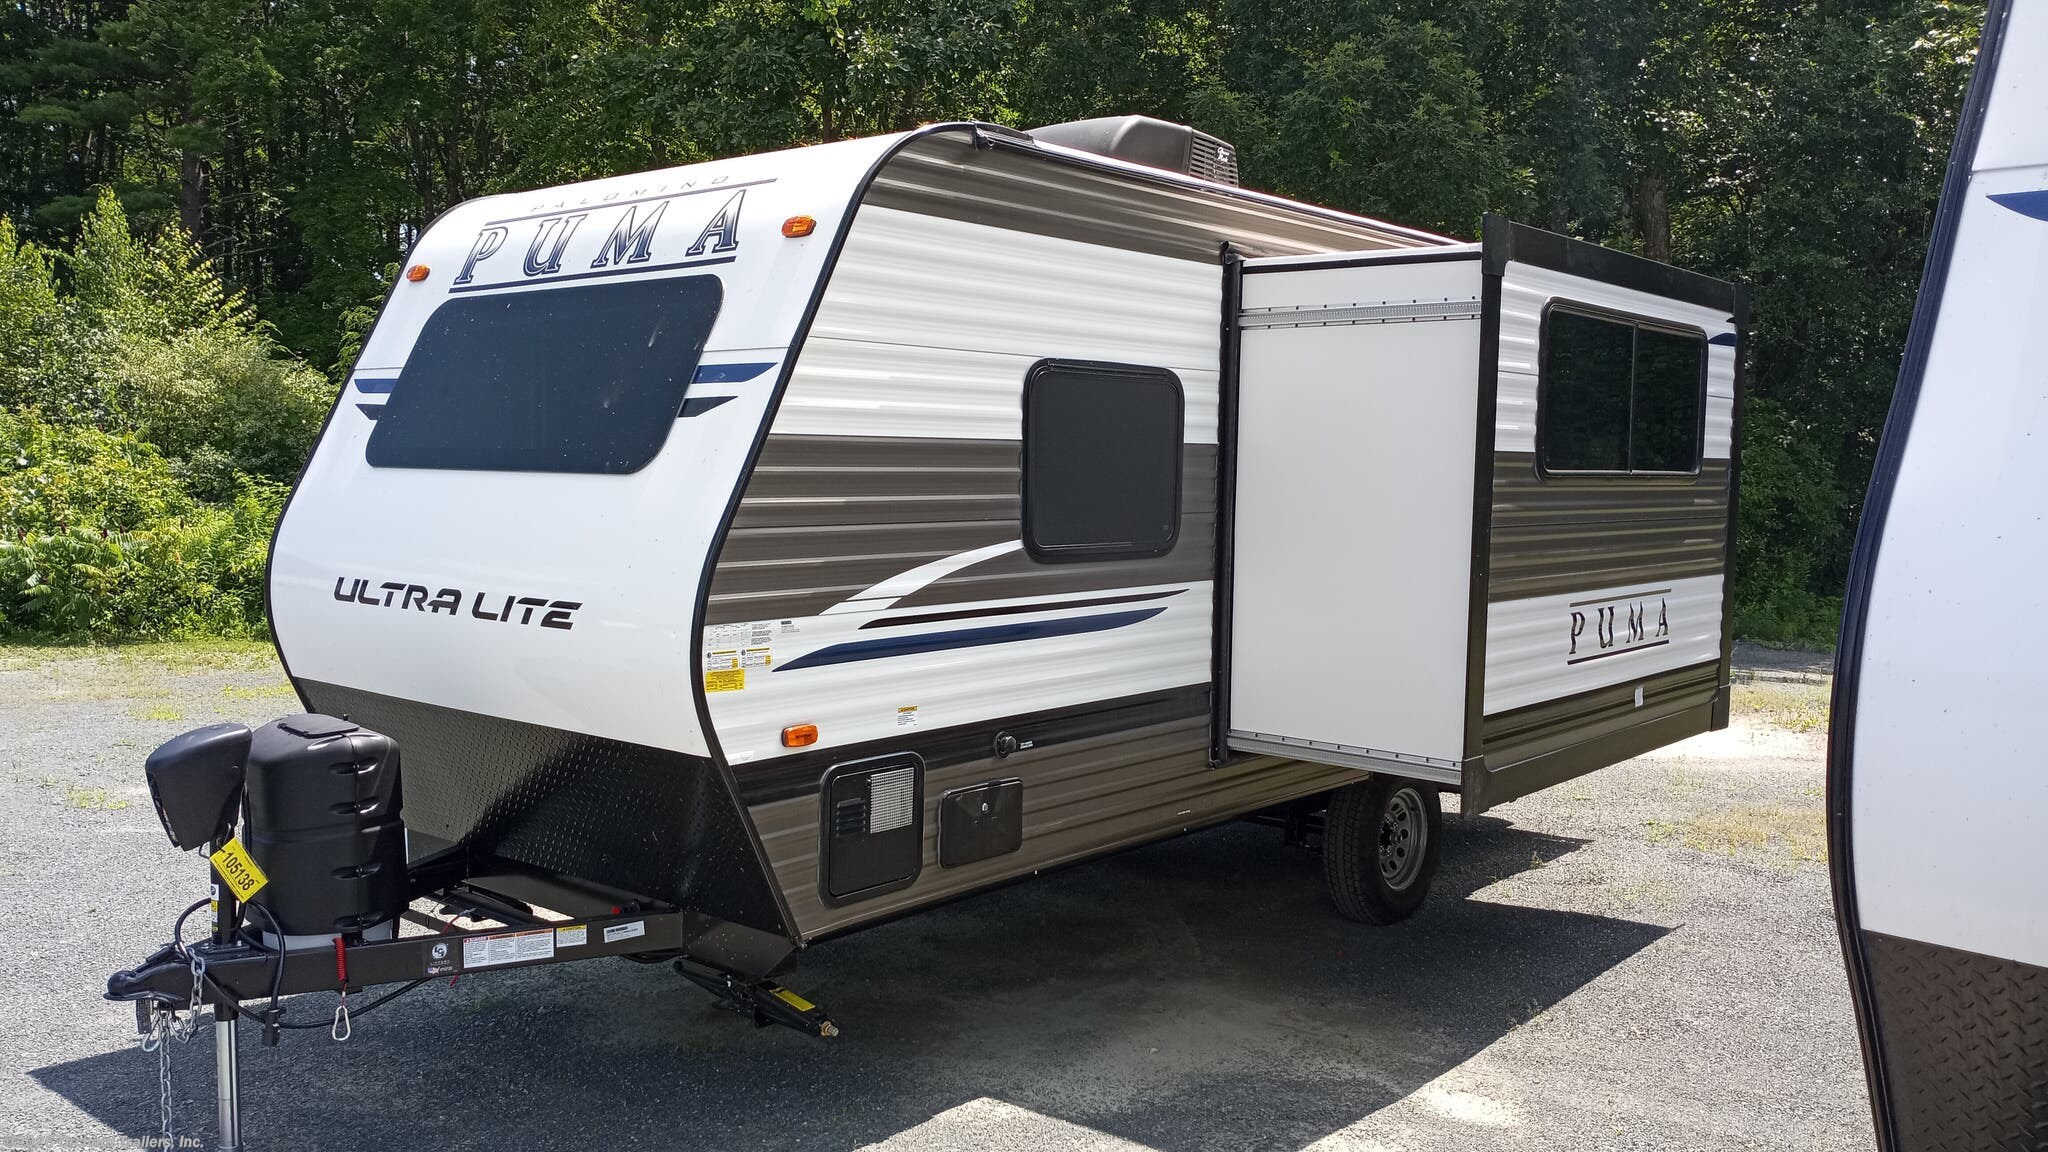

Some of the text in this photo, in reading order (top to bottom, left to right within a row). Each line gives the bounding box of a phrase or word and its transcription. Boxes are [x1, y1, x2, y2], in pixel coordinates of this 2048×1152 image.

[531, 175, 729, 213] PALOMINO
[453, 188, 748, 285] PUMA
[334, 577, 584, 630] ULTRA LITE
[1568, 597, 1669, 655] PUMA
[222, 851, 255, 891] 105138
